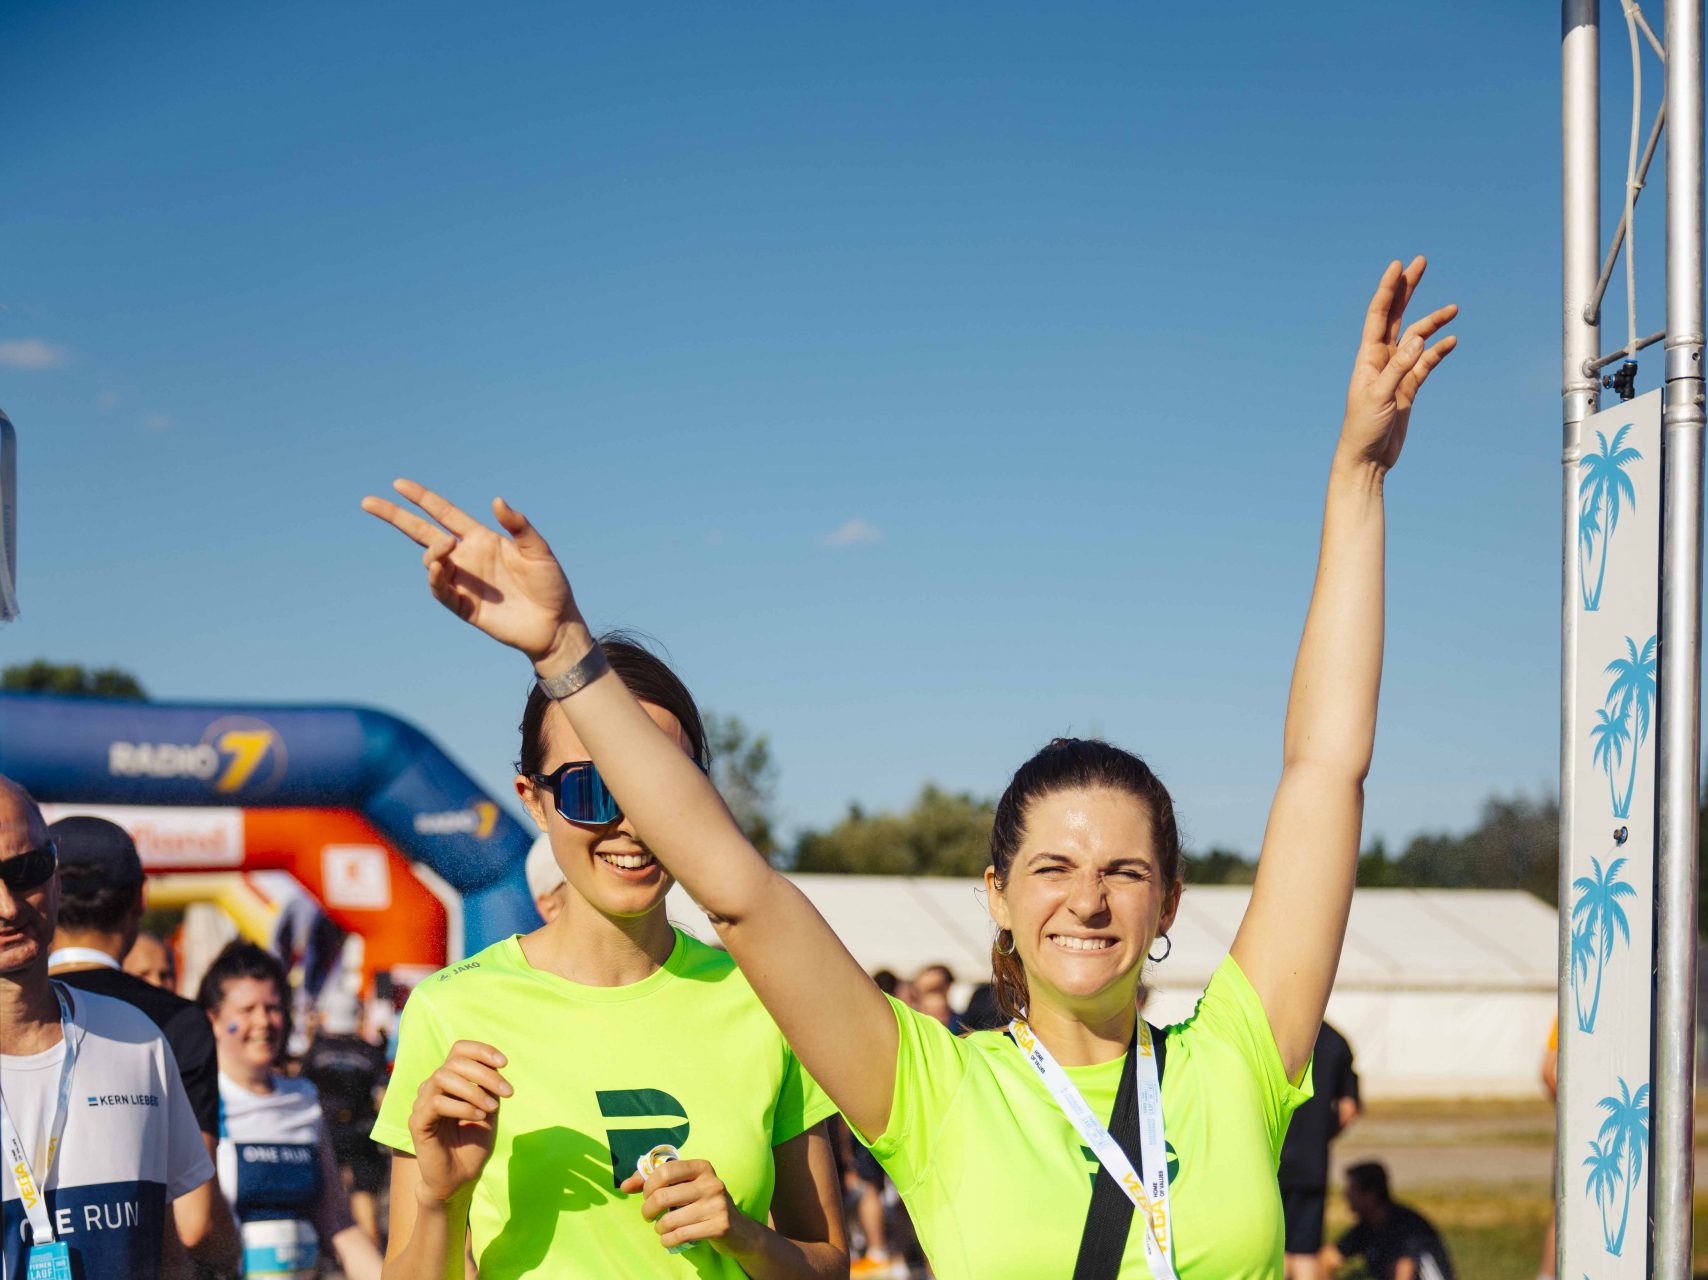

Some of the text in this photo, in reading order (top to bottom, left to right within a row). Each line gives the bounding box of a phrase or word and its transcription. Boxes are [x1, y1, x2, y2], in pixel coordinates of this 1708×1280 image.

[108, 730, 275, 794] RADIO 7
[453, 961, 481, 975] JAKO
[1033, 1049, 1044, 1063] HOME
[100, 1095, 129, 1105] KERN
[243, 1146, 279, 1163] ONE
[14, 1162, 37, 1210] VEGA
[83, 1200, 140, 1232] RUN
[30, 1268, 52, 1280] LAUF
